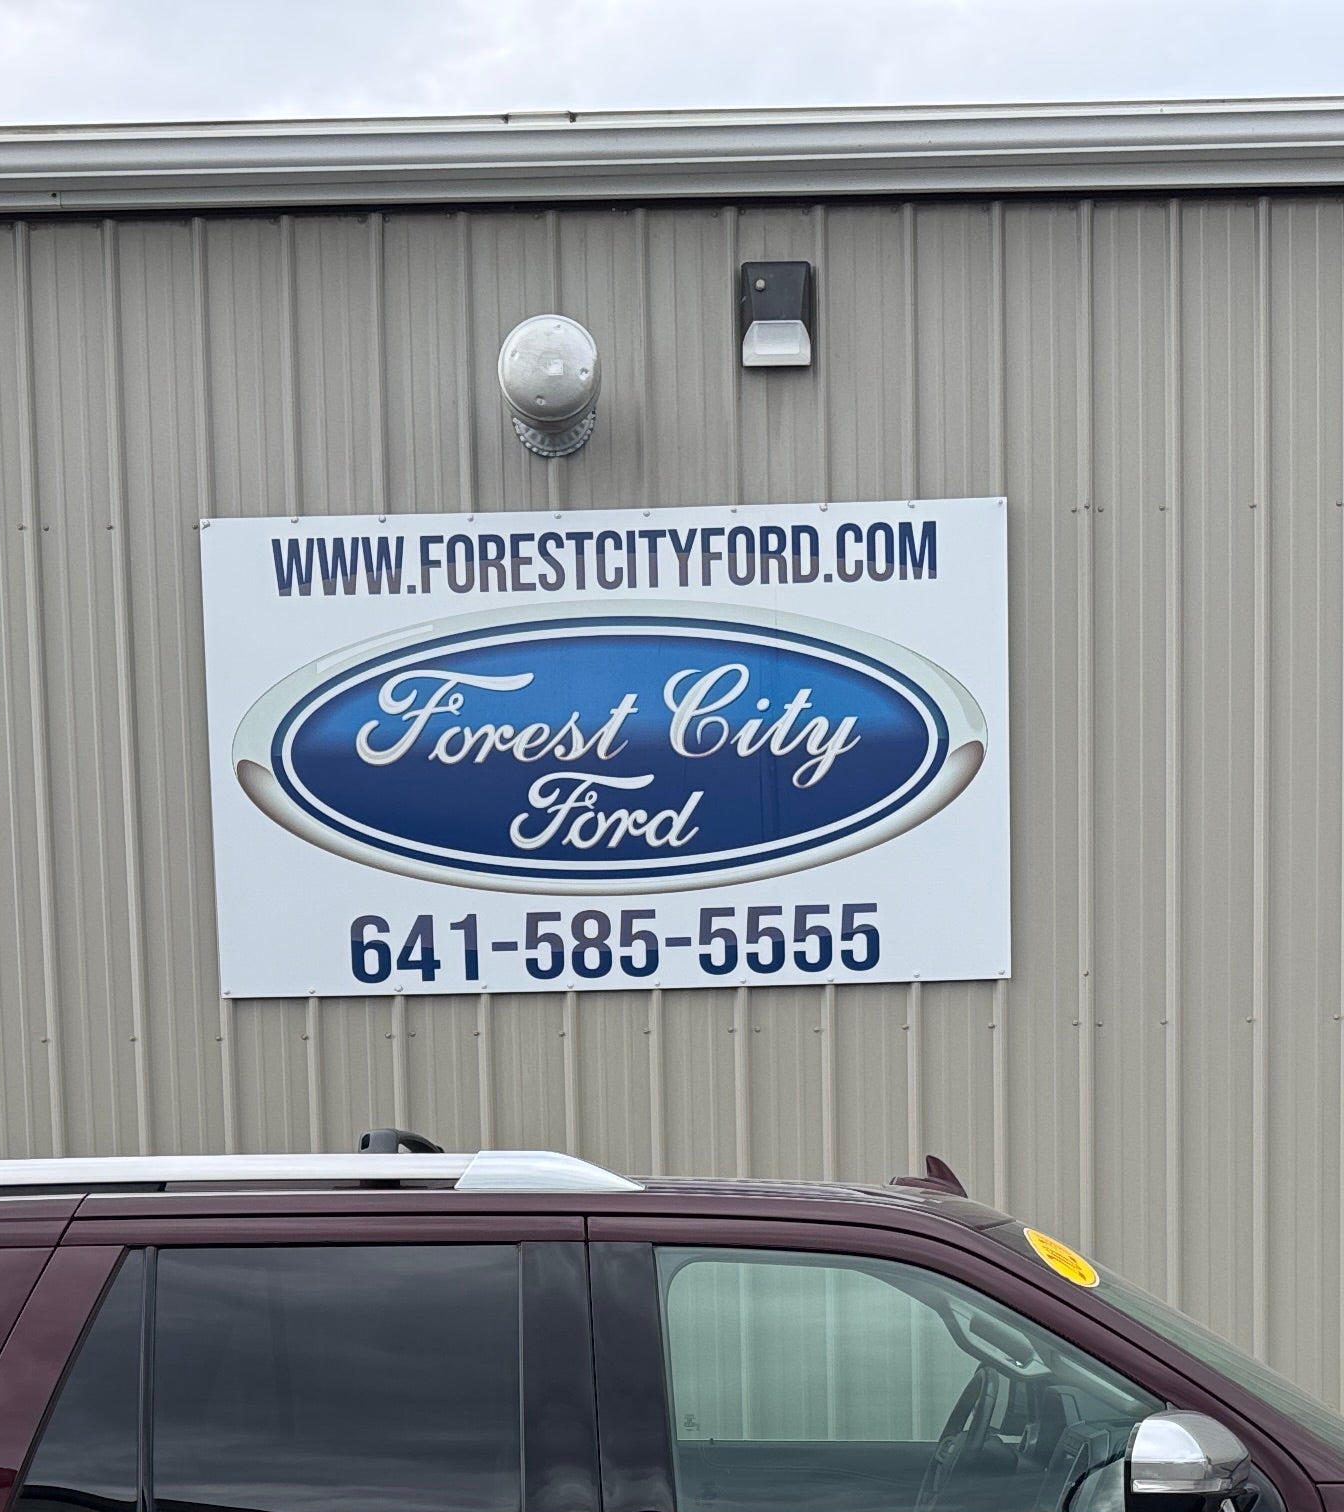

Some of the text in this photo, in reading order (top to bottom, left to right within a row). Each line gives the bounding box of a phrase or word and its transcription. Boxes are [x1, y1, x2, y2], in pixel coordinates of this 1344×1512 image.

[271, 520, 937, 597] WWW.FORESTCITYFORD.COM
[355, 662, 862, 789] Forest City
[507, 770, 704, 851] Ford
[349, 902, 881, 983] 641-585-5555
